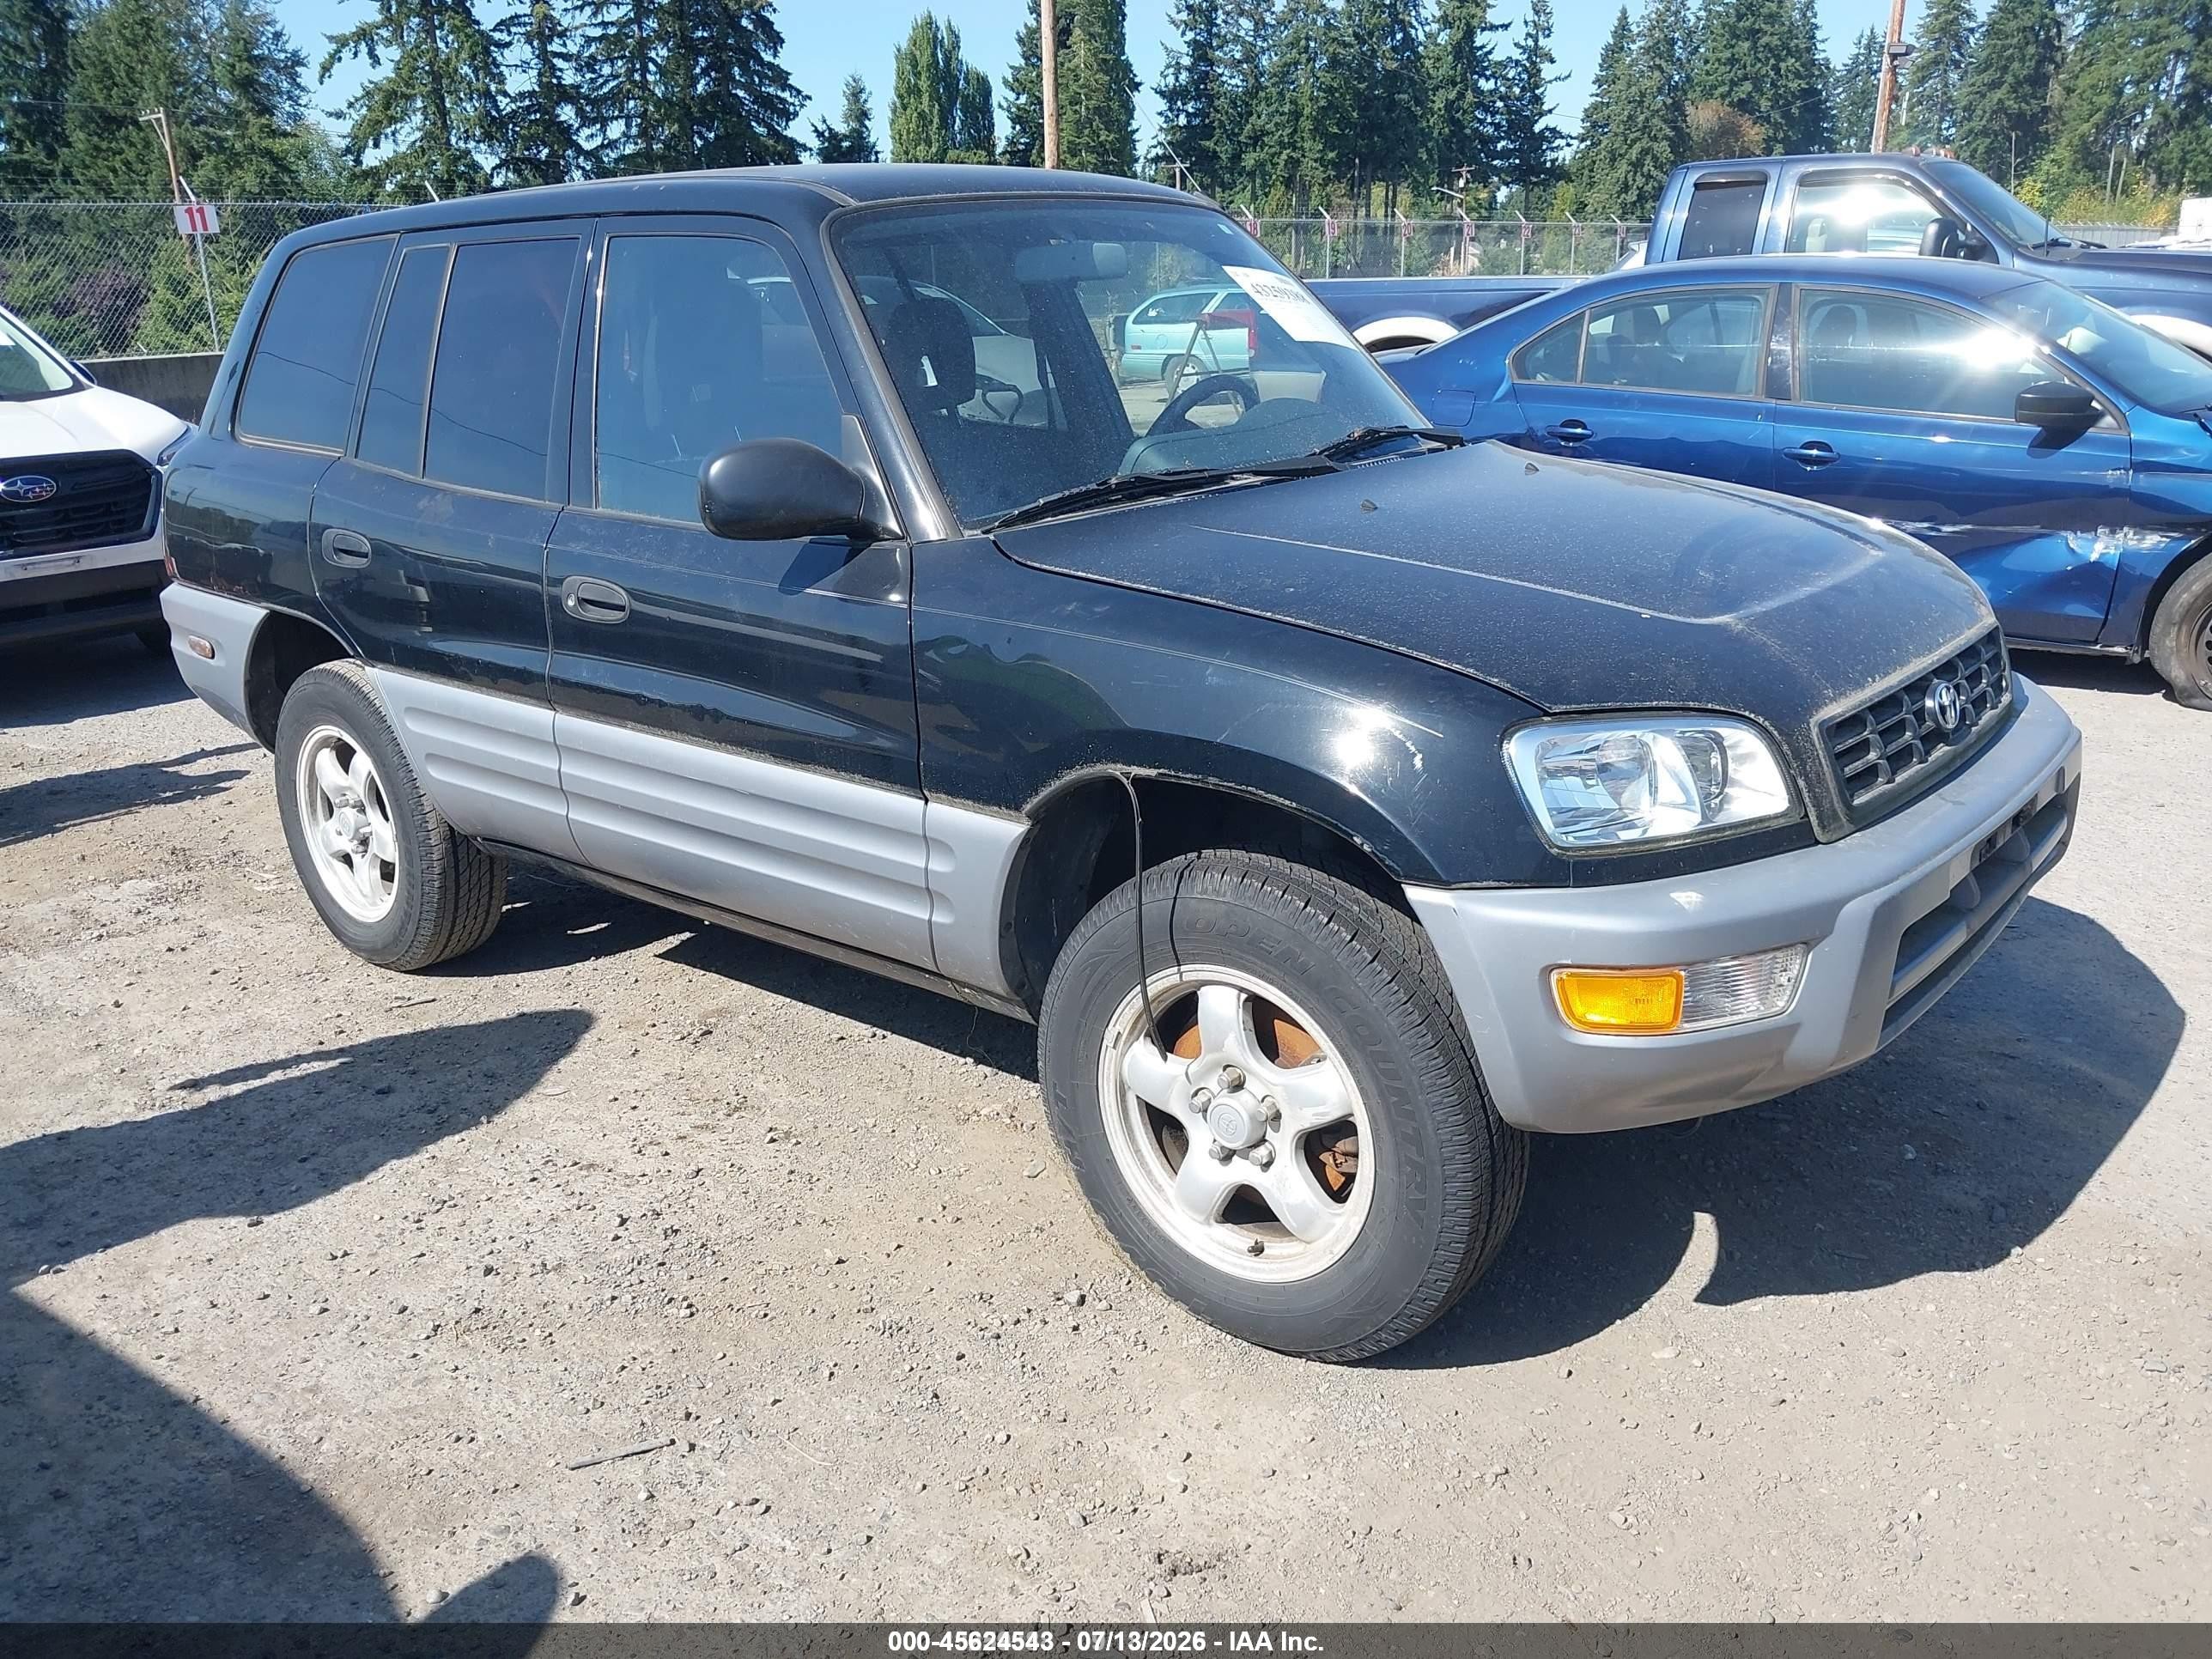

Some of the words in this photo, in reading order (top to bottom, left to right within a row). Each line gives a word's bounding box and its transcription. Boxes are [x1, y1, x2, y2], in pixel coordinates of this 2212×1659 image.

[185, 207, 209, 232] 11
[1327, 220, 1336, 235] 19
[1249, 221, 1259, 237] 18
[1403, 222, 1413, 237] 20
[1186, 918, 1316, 975] OPEN
[1325, 986, 1426, 1229] COUNTRY
